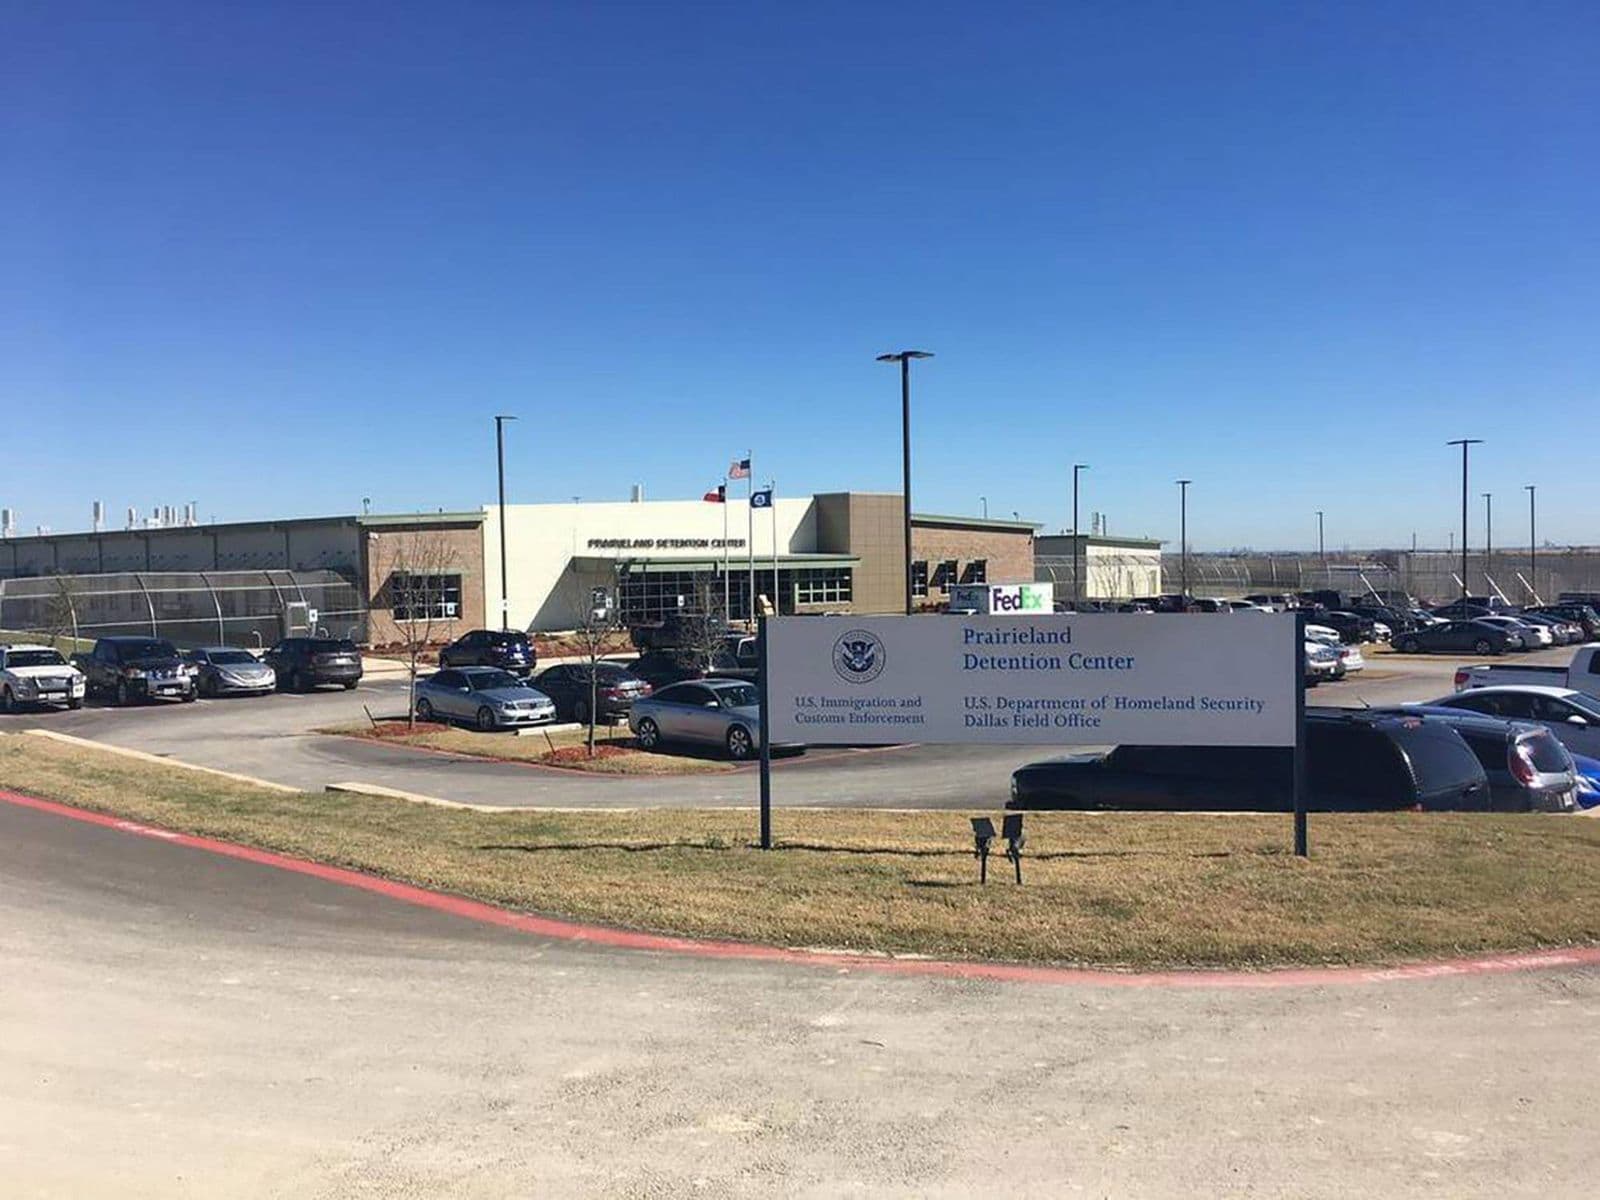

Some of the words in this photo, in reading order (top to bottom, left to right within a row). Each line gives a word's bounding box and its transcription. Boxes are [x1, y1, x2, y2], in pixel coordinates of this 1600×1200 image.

[587, 538, 654, 549] PRAIRIELAND
[656, 538, 709, 548] DETENTION
[711, 538, 746, 548] CENTER
[993, 586, 1042, 611] FedEx
[963, 626, 1072, 645] Prairieland
[963, 652, 1061, 670] Detention
[1068, 652, 1135, 670] Center
[795, 696, 817, 708] U.S.
[821, 696, 897, 710] Immigration
[900, 696, 922, 708] and
[964, 696, 992, 709] U.S.
[996, 696, 1086, 713] Department
[1090, 695, 1109, 709] of
[1114, 695, 1195, 710] Homeland
[1200, 696, 1265, 714] Security
[795, 712, 845, 724] Customs
[849, 712, 925, 724] Enforcement
[964, 714, 1008, 728] Dallas
[1013, 714, 1049, 728] Field
[1054, 714, 1101, 728] Office
